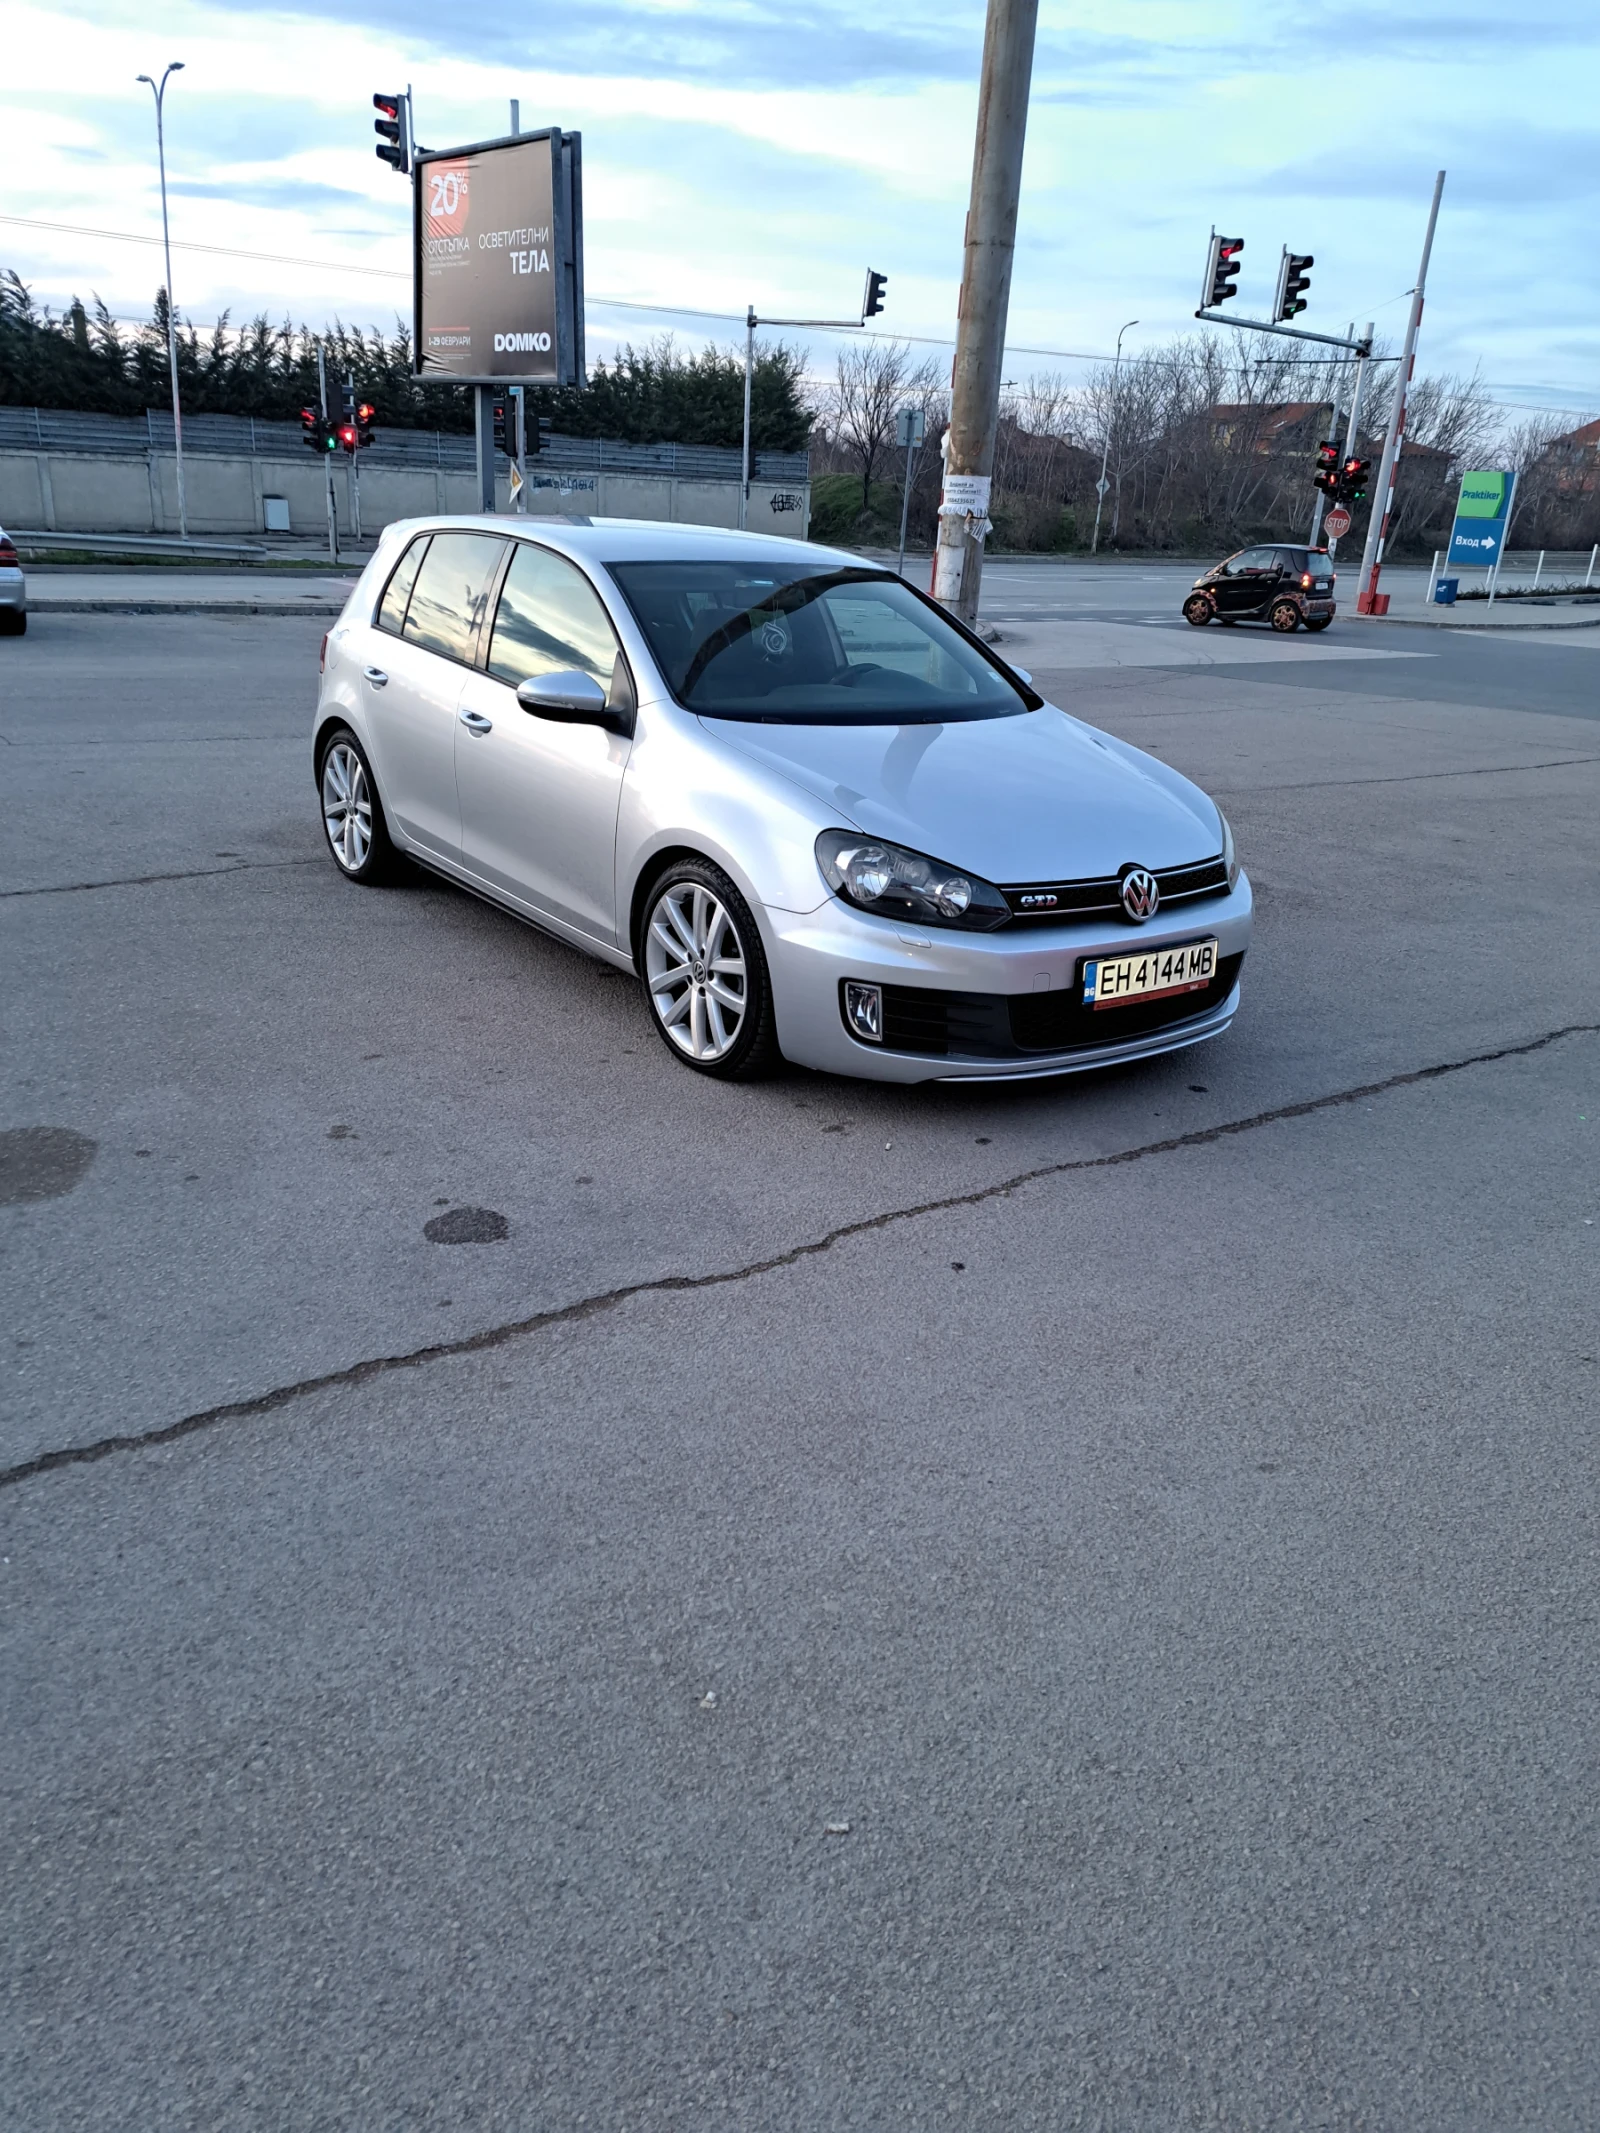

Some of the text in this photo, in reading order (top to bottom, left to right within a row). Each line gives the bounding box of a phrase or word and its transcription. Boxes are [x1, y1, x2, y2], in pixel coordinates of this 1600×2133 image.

[430, 171, 468, 217] 20%
[478, 226, 549, 250] ОСВЕТИТЕЛНИ
[429, 236, 470, 255] ОТСТЪПКА
[509, 249, 550, 275] ТЕЛА
[440, 336, 471, 346] ФЕВРУАРИ
[494, 332, 551, 352] DOMKO
[1462, 490, 1500, 500] Praktiker
[1327, 517, 1349, 529] STOP
[1455, 535, 1480, 548] Вход
[1020, 894, 1058, 908] GTD
[1084, 987, 1095, 997] BG
